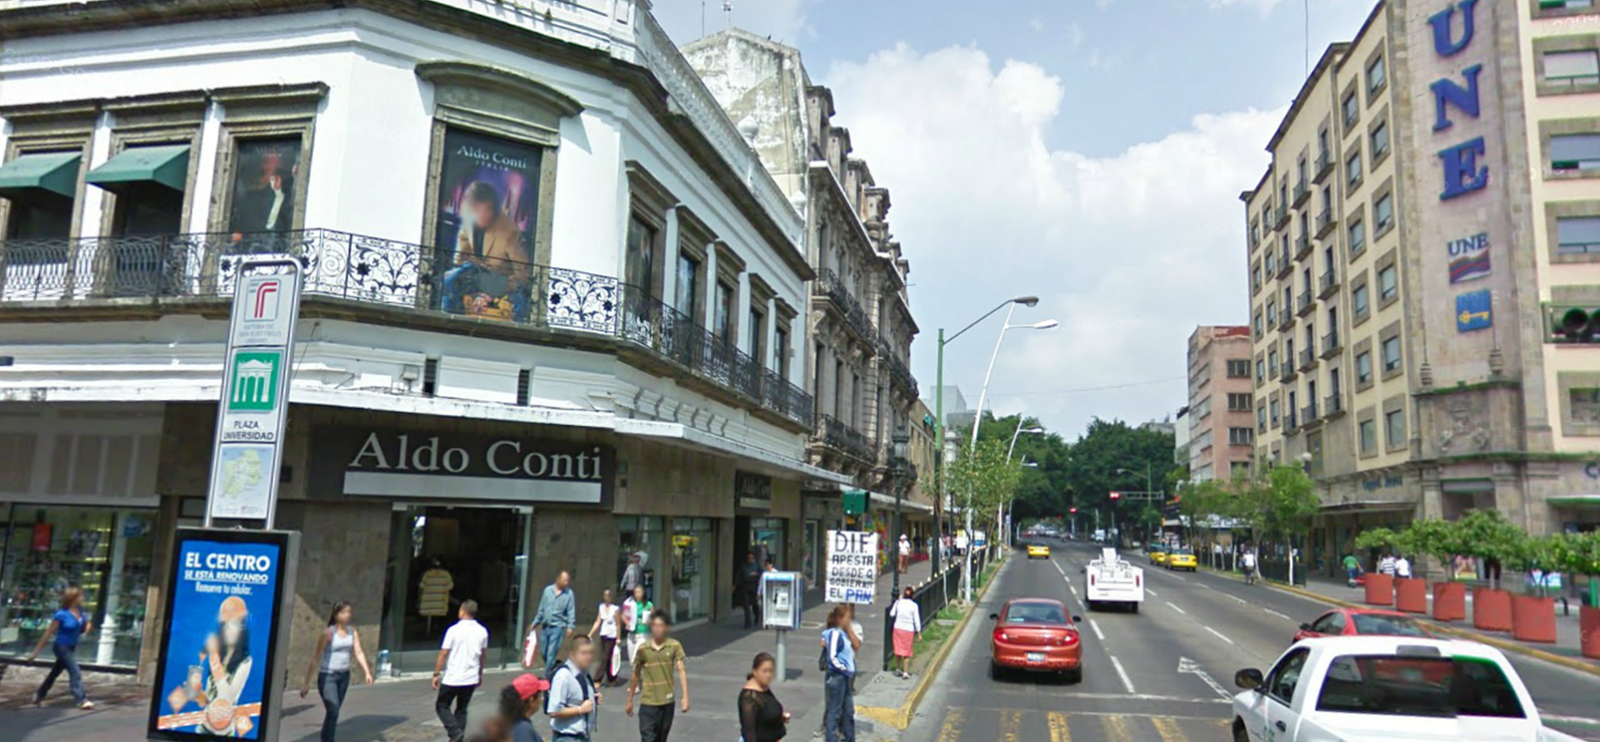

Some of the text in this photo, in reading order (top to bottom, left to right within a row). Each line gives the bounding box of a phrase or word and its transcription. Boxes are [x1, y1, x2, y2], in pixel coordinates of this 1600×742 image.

[1427, 0, 1490, 200] UNE
[457, 145, 527, 169] Aldo Conti
[475, 160, 510, 172] ITALIA
[1447, 232, 1489, 256] UNE
[233, 420, 260, 429] PLAZA
[348, 431, 603, 480] Aldo Conti
[186, 552, 271, 571] EL CENTRO
[832, 555, 873, 565] APESTA
[185, 570, 193, 579] SE
[216, 572, 269, 583] RENOVANDO
[832, 567, 864, 577] DESDE
[196, 582, 221, 592] Renueva
[830, 588, 871, 601] EL PAN
